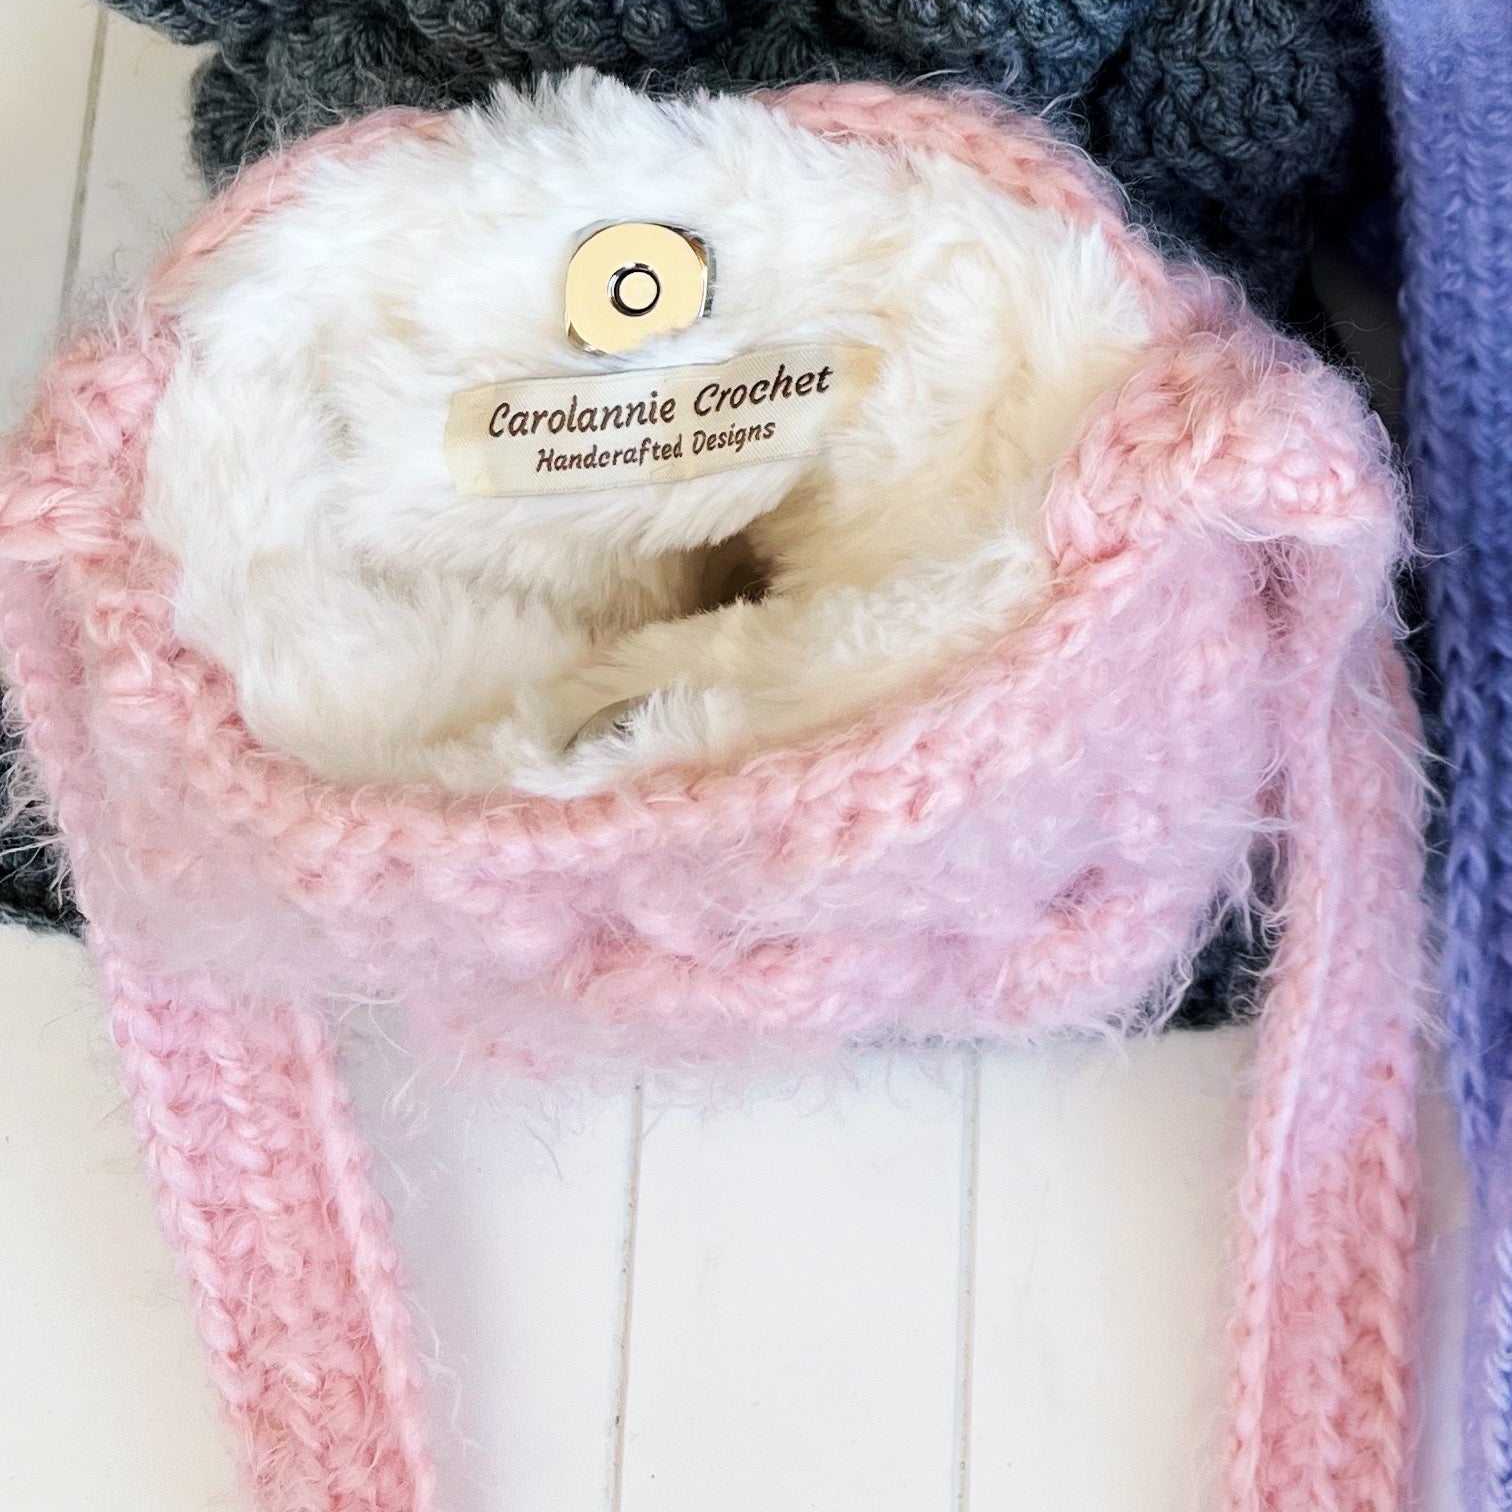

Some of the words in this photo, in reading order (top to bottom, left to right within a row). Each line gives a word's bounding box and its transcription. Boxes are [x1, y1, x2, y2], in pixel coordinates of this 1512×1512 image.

[488, 391, 676, 437] Carolannie
[693, 364, 833, 416] Crochet
[536, 432, 683, 473] Handcrafted
[692, 420, 777, 456] Designs
